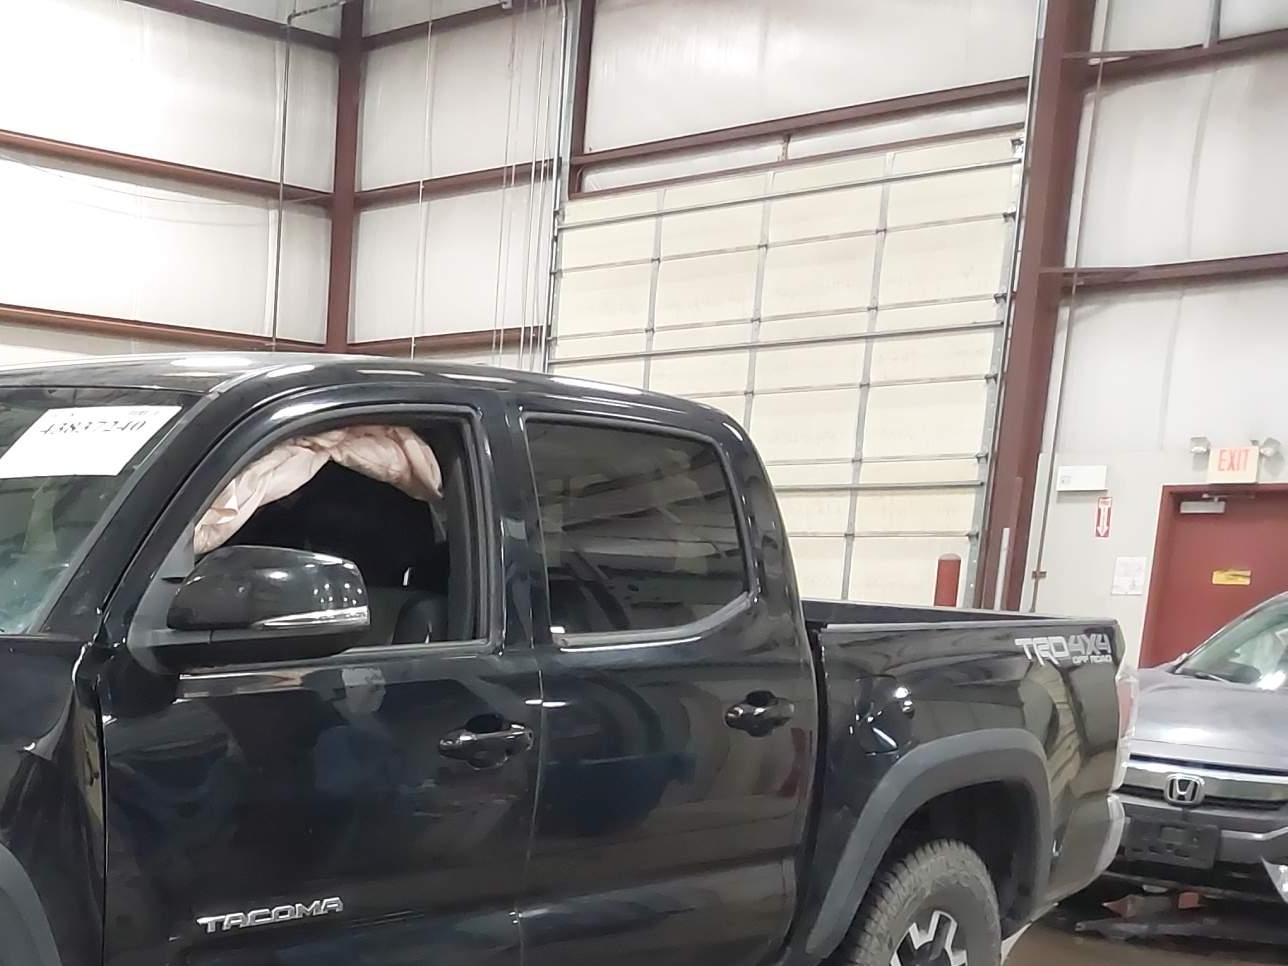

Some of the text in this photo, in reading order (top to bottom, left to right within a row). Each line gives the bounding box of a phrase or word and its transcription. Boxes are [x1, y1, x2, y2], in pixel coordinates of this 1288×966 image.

[1218, 448, 1250, 473] EXIT
[1015, 635, 1070, 666] TRD
[197, 896, 344, 933] TACOMA
